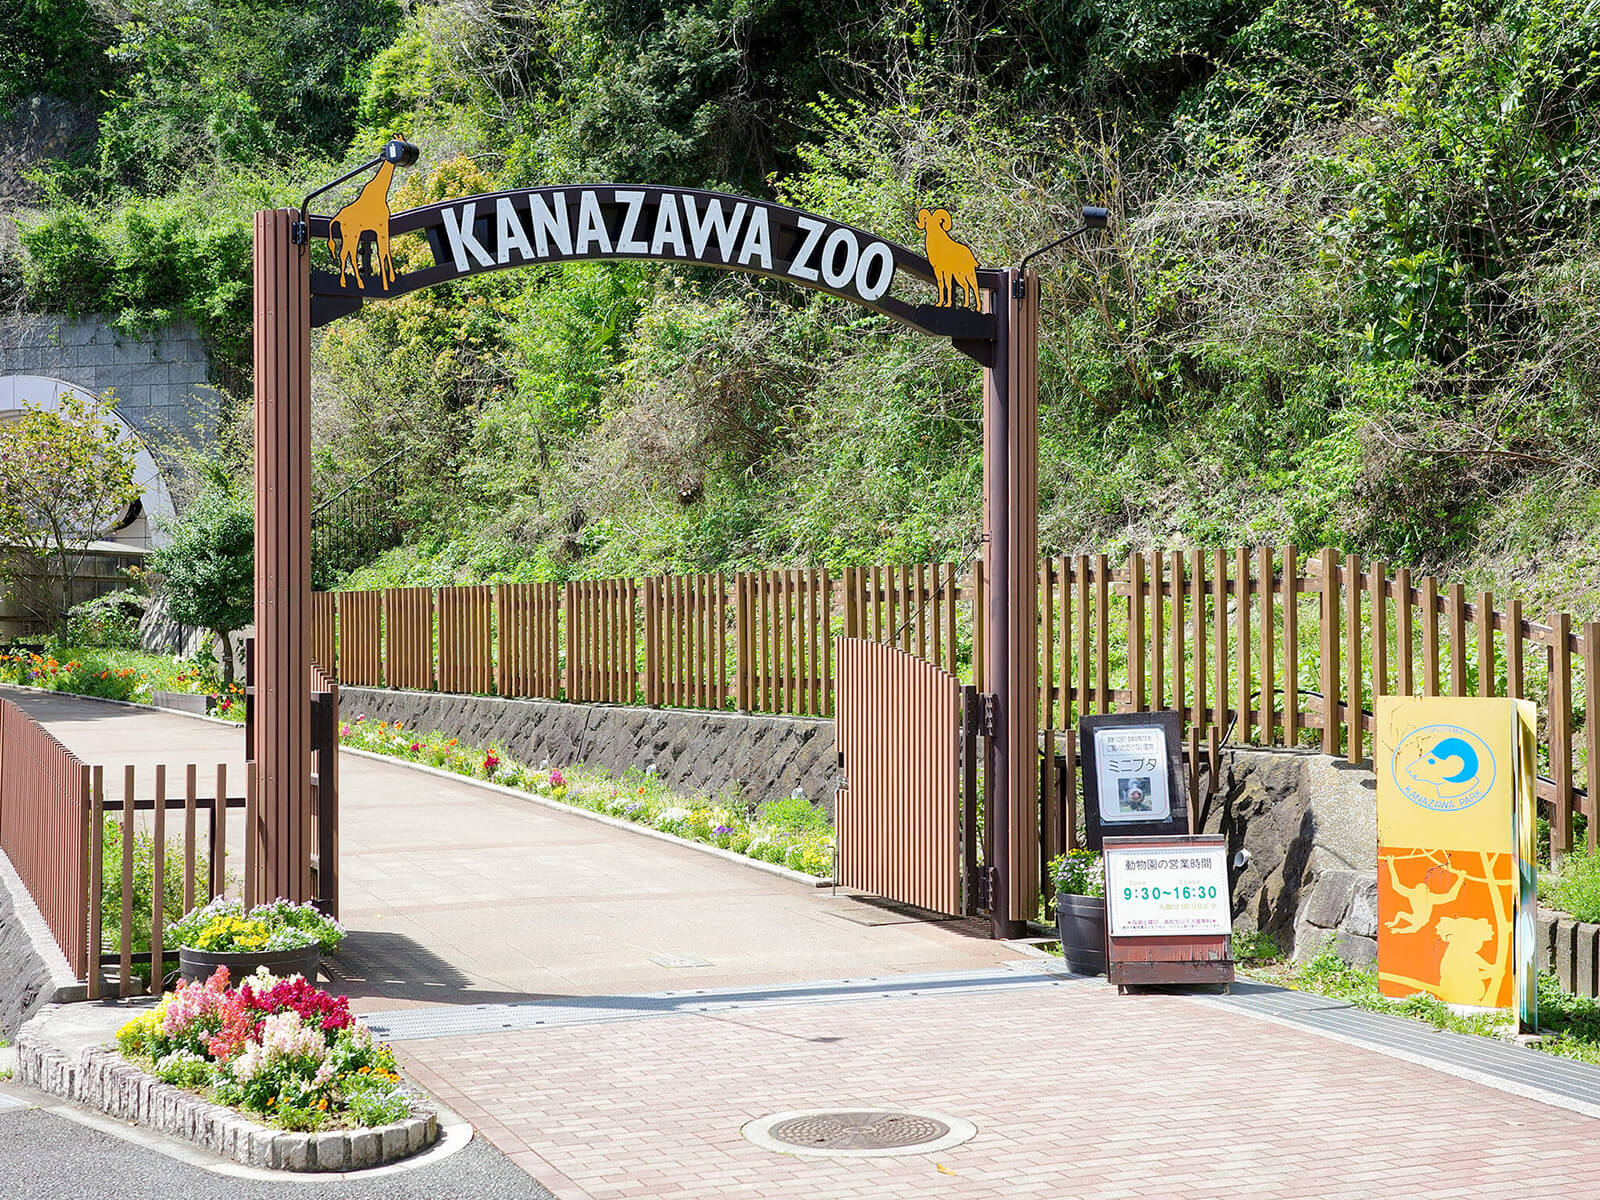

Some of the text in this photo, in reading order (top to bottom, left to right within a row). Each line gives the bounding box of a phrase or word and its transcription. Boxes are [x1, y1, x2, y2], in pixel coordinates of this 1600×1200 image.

[440, 190, 895, 301] KANAZAWA ZOO
[1108, 757, 1157, 773] ミニブタ
[1404, 785, 1482, 809] KANAZAWA PARK
[1125, 858, 1212, 871] 動物園の営業時間
